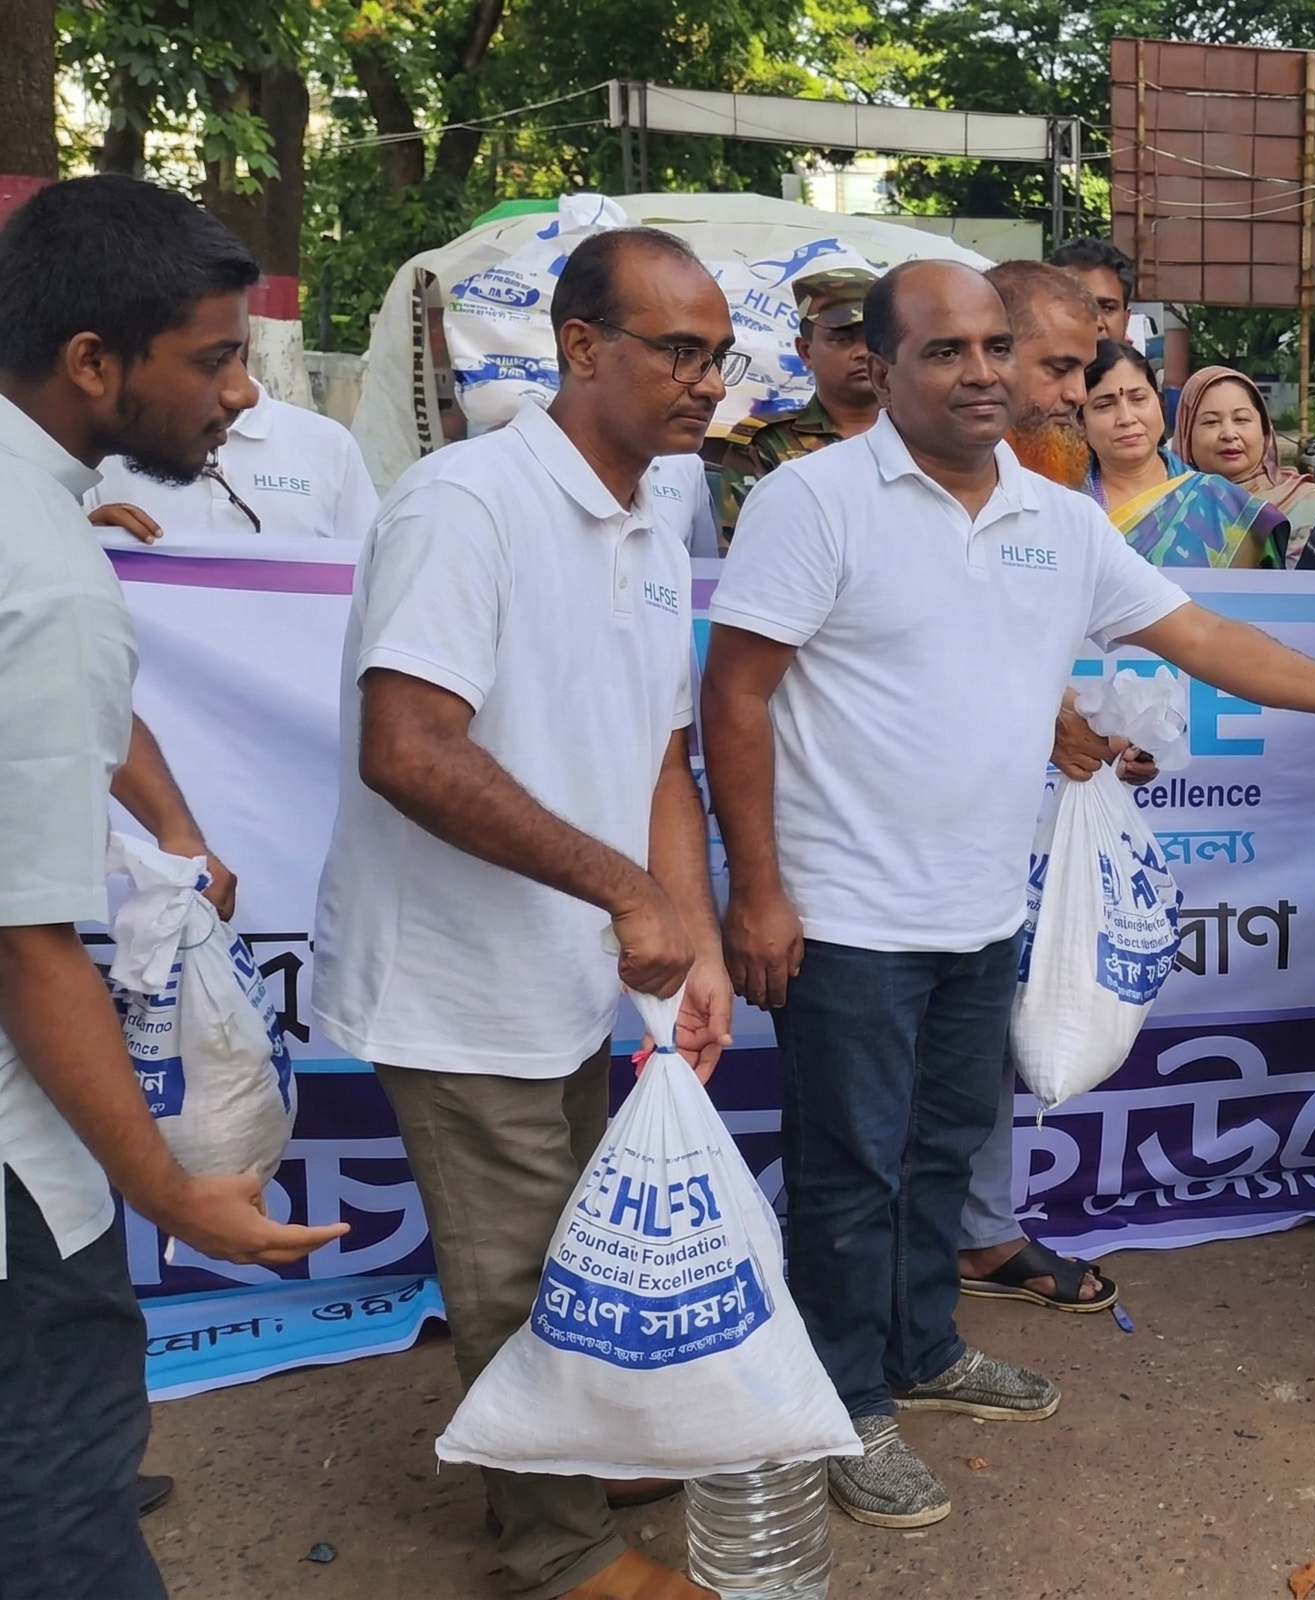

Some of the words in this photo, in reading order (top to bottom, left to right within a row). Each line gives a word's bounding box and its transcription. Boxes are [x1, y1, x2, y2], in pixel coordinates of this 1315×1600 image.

[253, 474, 311, 492] HLFSE
[1001, 544, 1057, 565] HLFSE
[643, 580, 678, 608] HLFSE
[579, 1255, 635, 1287] Social
[638, 1256, 734, 1291] Excellence
